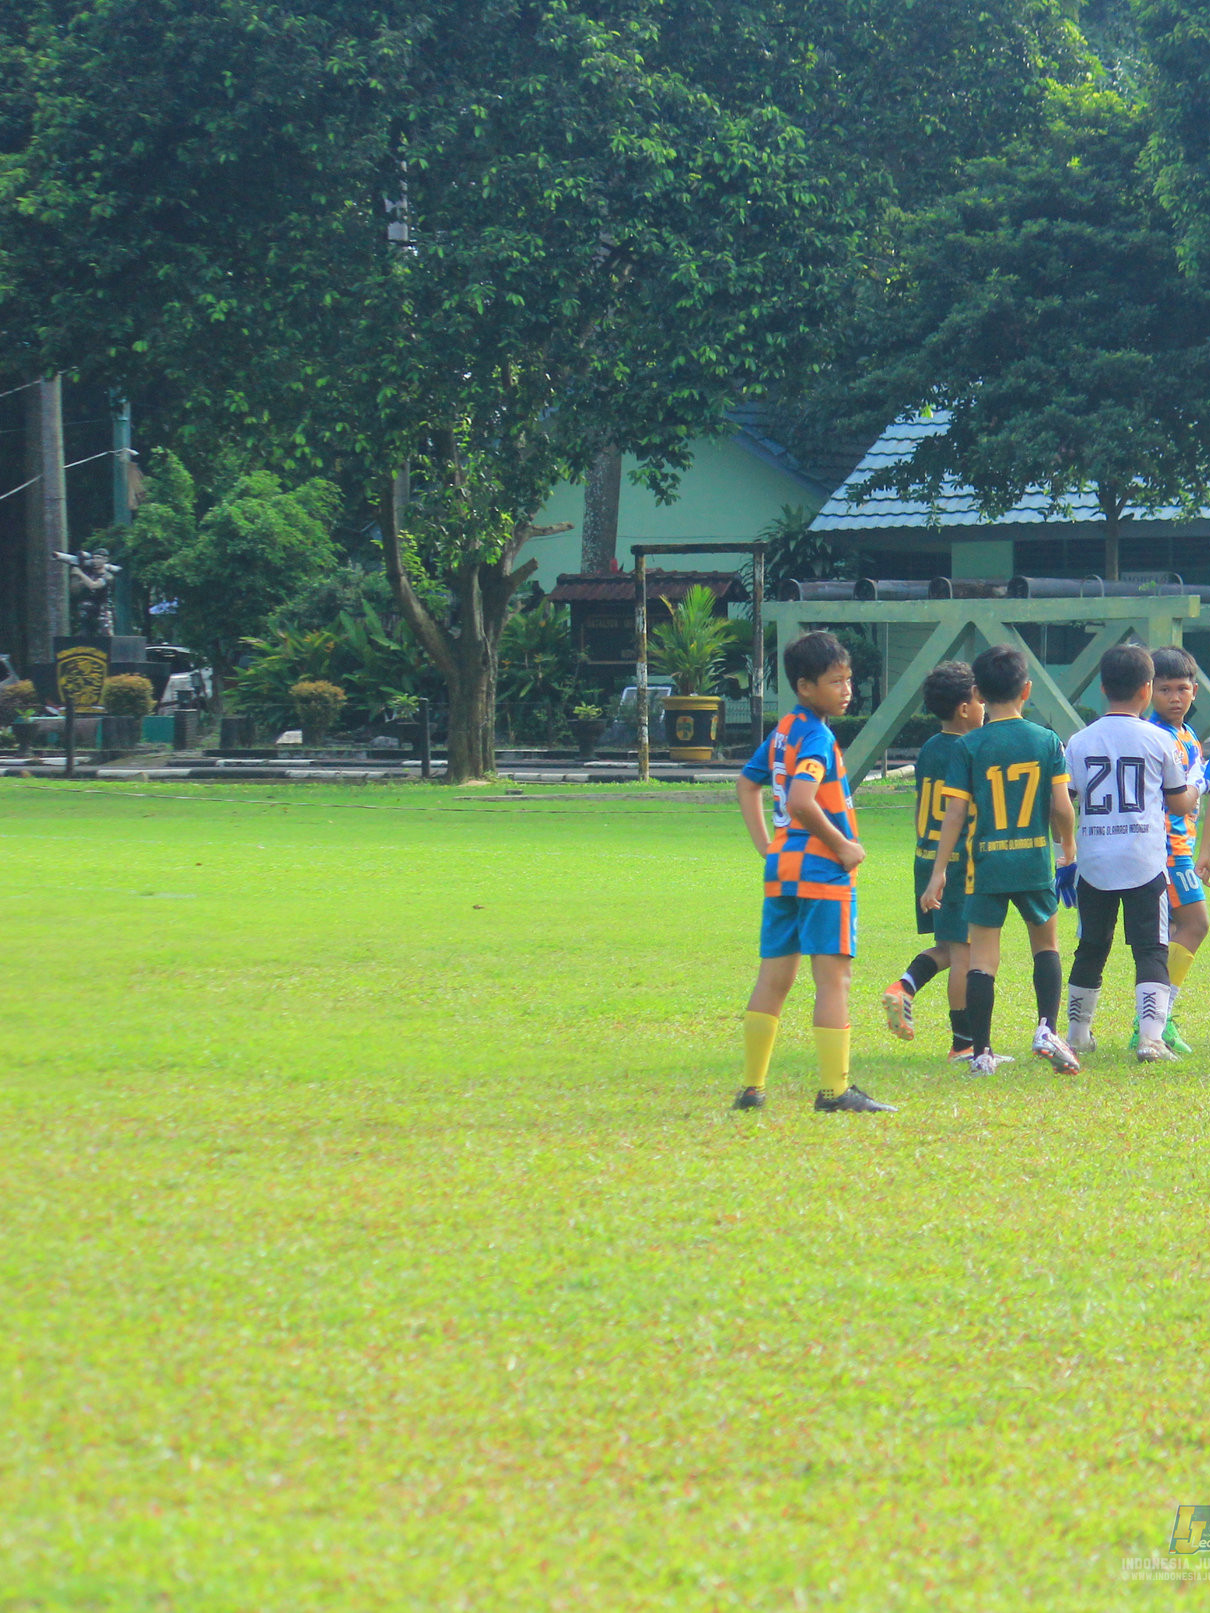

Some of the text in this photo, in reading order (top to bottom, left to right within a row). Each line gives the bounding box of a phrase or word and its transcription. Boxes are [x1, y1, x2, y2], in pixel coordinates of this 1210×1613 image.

[805, 762, 819, 774] C
[1084, 755, 1145, 816] 20
[986, 761, 1040, 830] 17
[1176, 868, 1200, 892] 10
